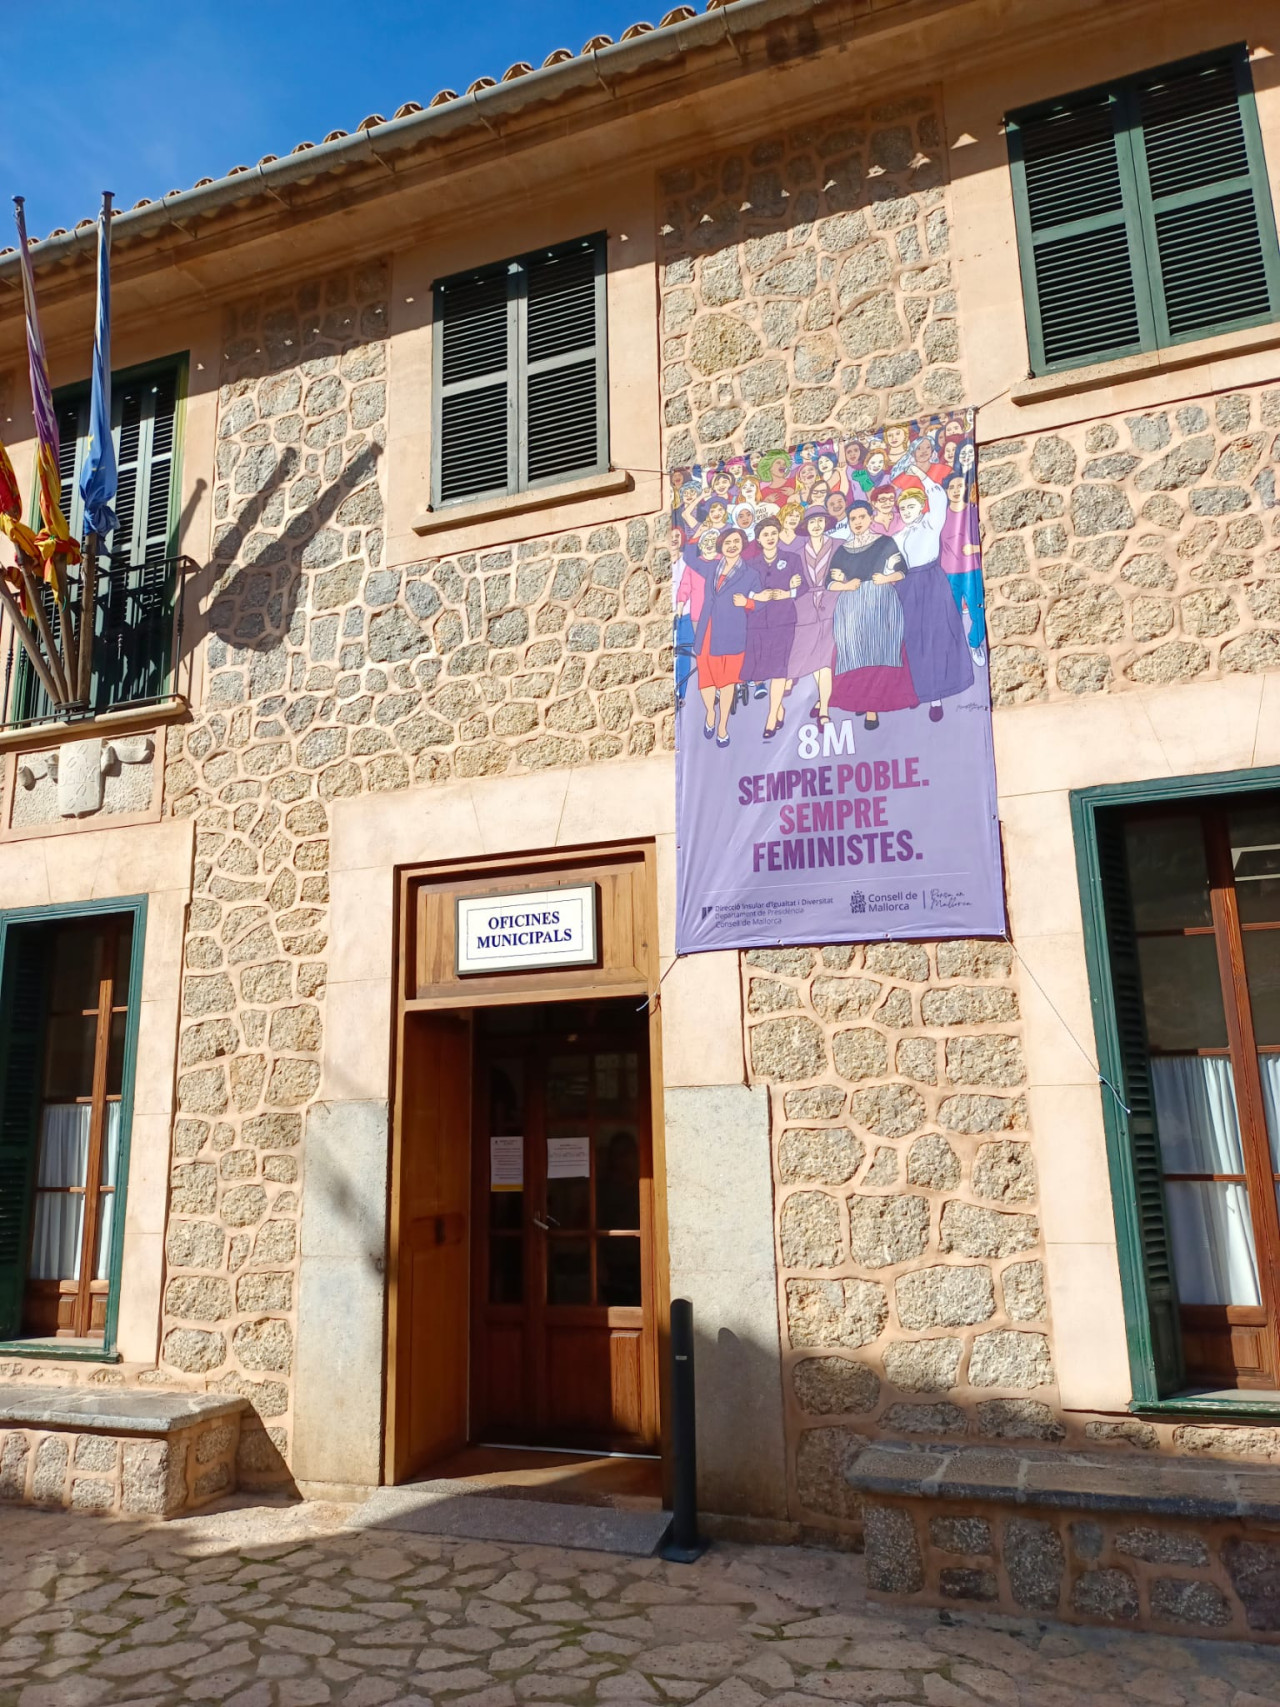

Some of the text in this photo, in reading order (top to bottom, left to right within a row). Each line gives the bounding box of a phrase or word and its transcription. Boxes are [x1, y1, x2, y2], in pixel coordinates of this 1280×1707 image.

[797, 719, 856, 760] 8M
[738, 757, 930, 806] SEMPRE POBLE.
[779, 796, 889, 835] SEMPRE
[752, 829, 923, 873] FEMINISTES.
[801, 897, 834, 905] Diversitat
[868, 891, 918, 903] Consell de
[868, 902, 910, 913] Mallorca
[488, 911, 560, 930] OFICINES
[742, 918, 751, 926] de
[752, 917, 782, 926] Mallorca
[477, 928, 572, 949] MUNICIPALS
